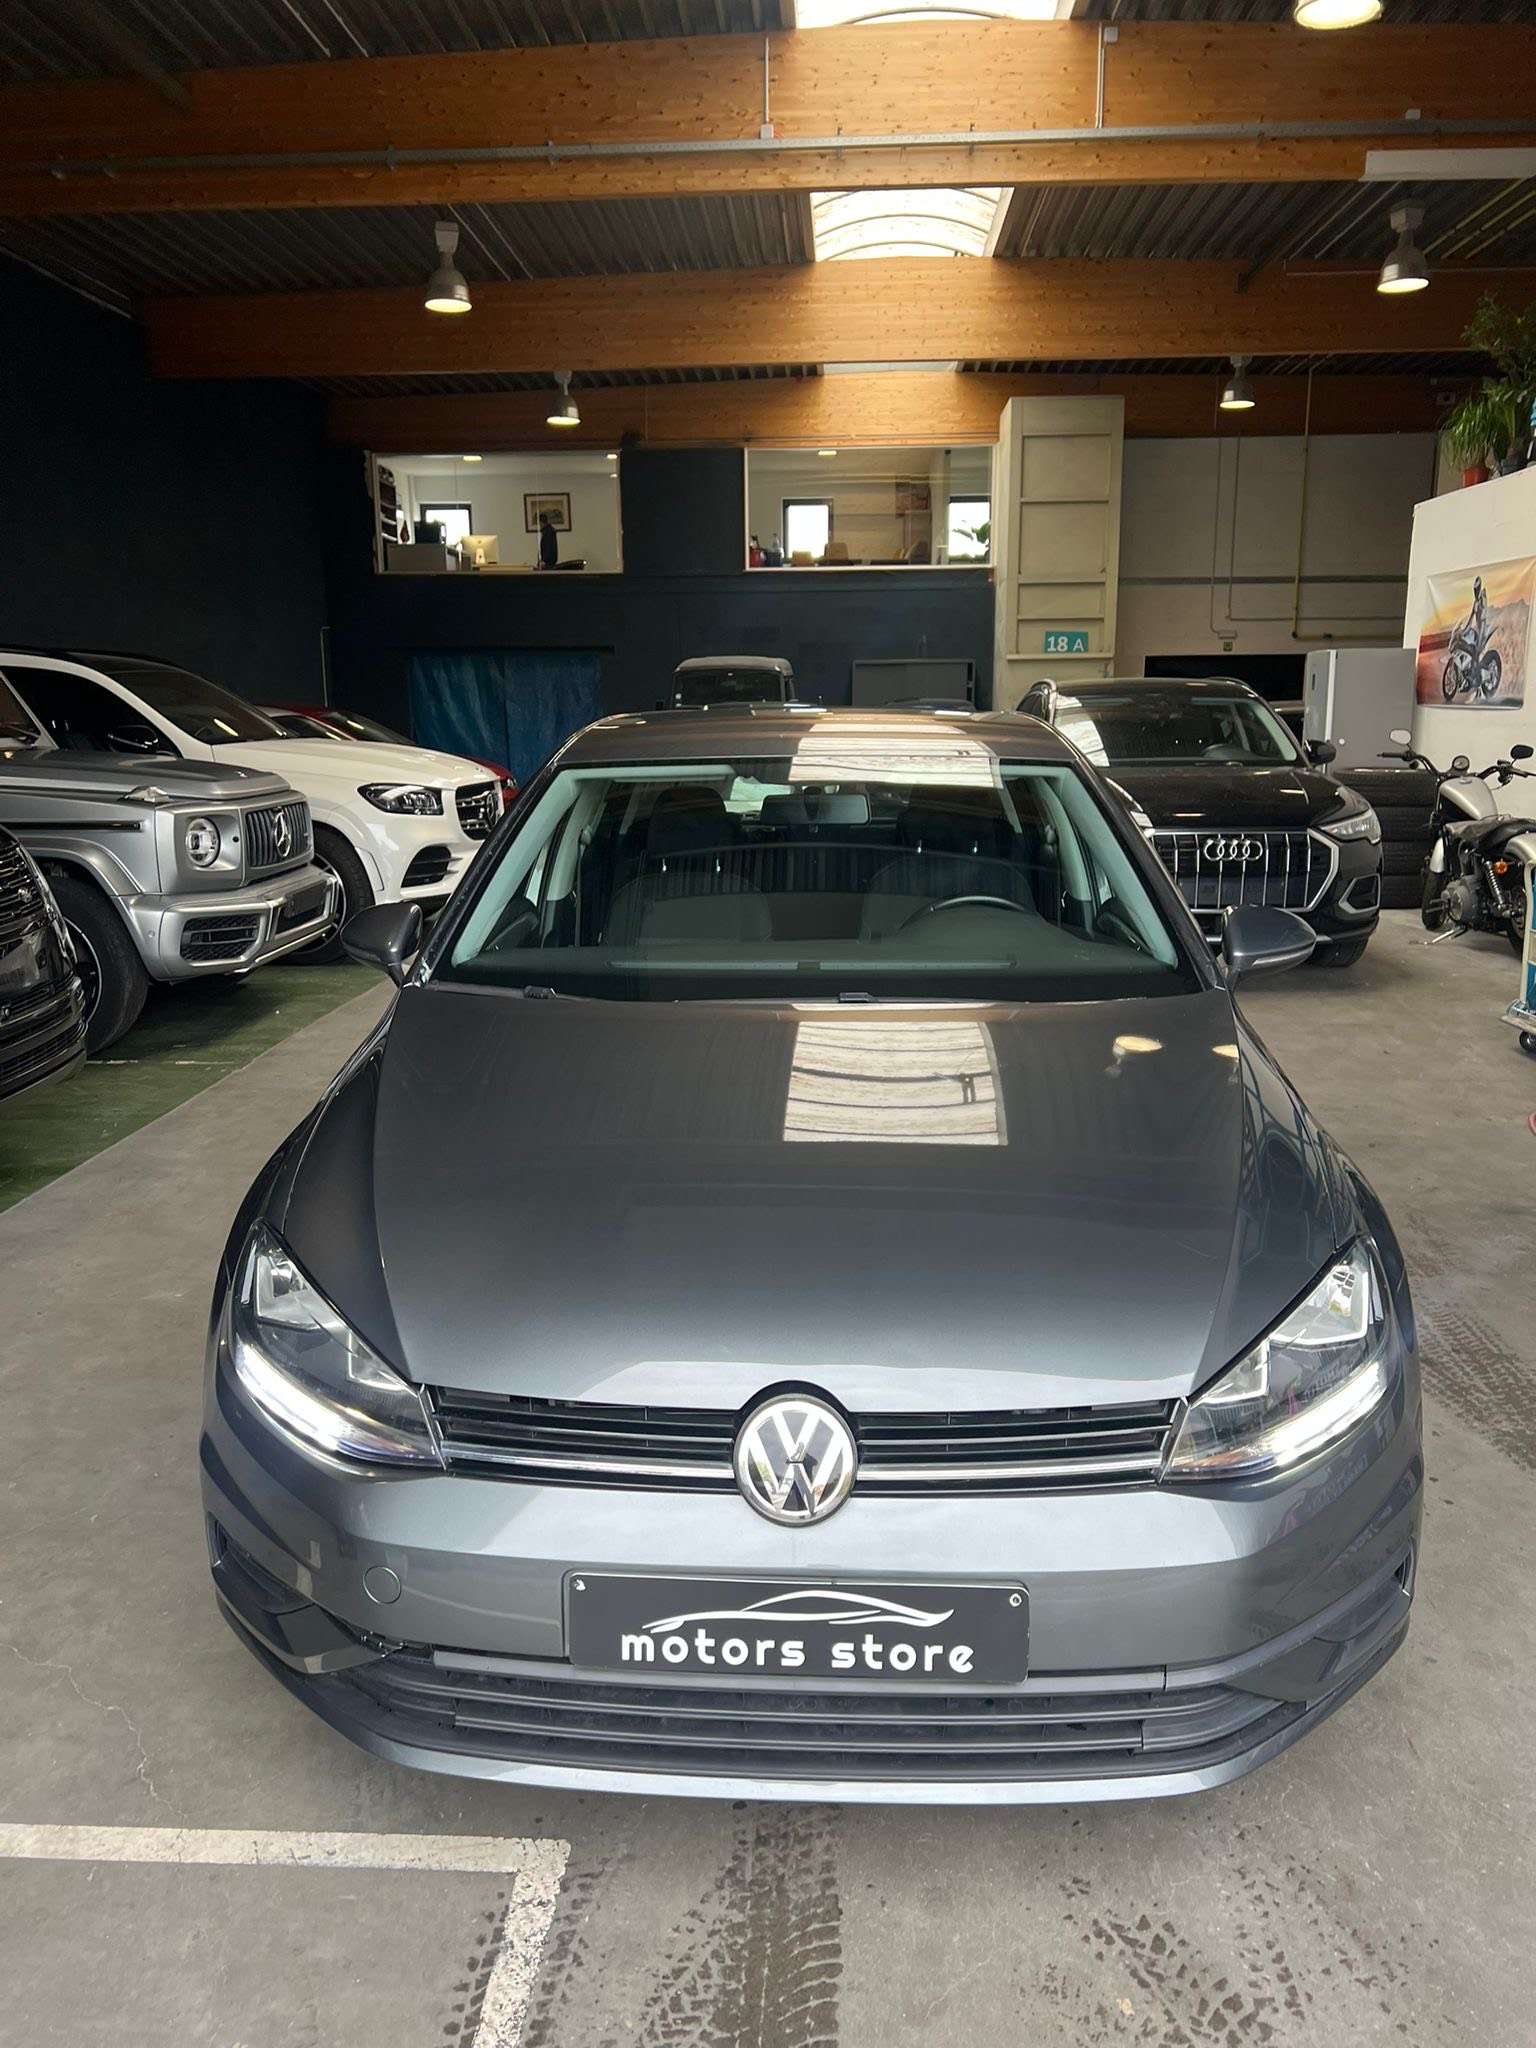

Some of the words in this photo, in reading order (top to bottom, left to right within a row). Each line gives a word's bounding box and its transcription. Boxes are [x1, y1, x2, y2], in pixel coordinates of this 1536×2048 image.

[1047, 635, 1069, 652] 18
[1072, 638, 1085, 652] A
[743, 1403, 849, 1515] VW
[621, 1628, 806, 1668] motors
[831, 1633, 975, 1674] store
